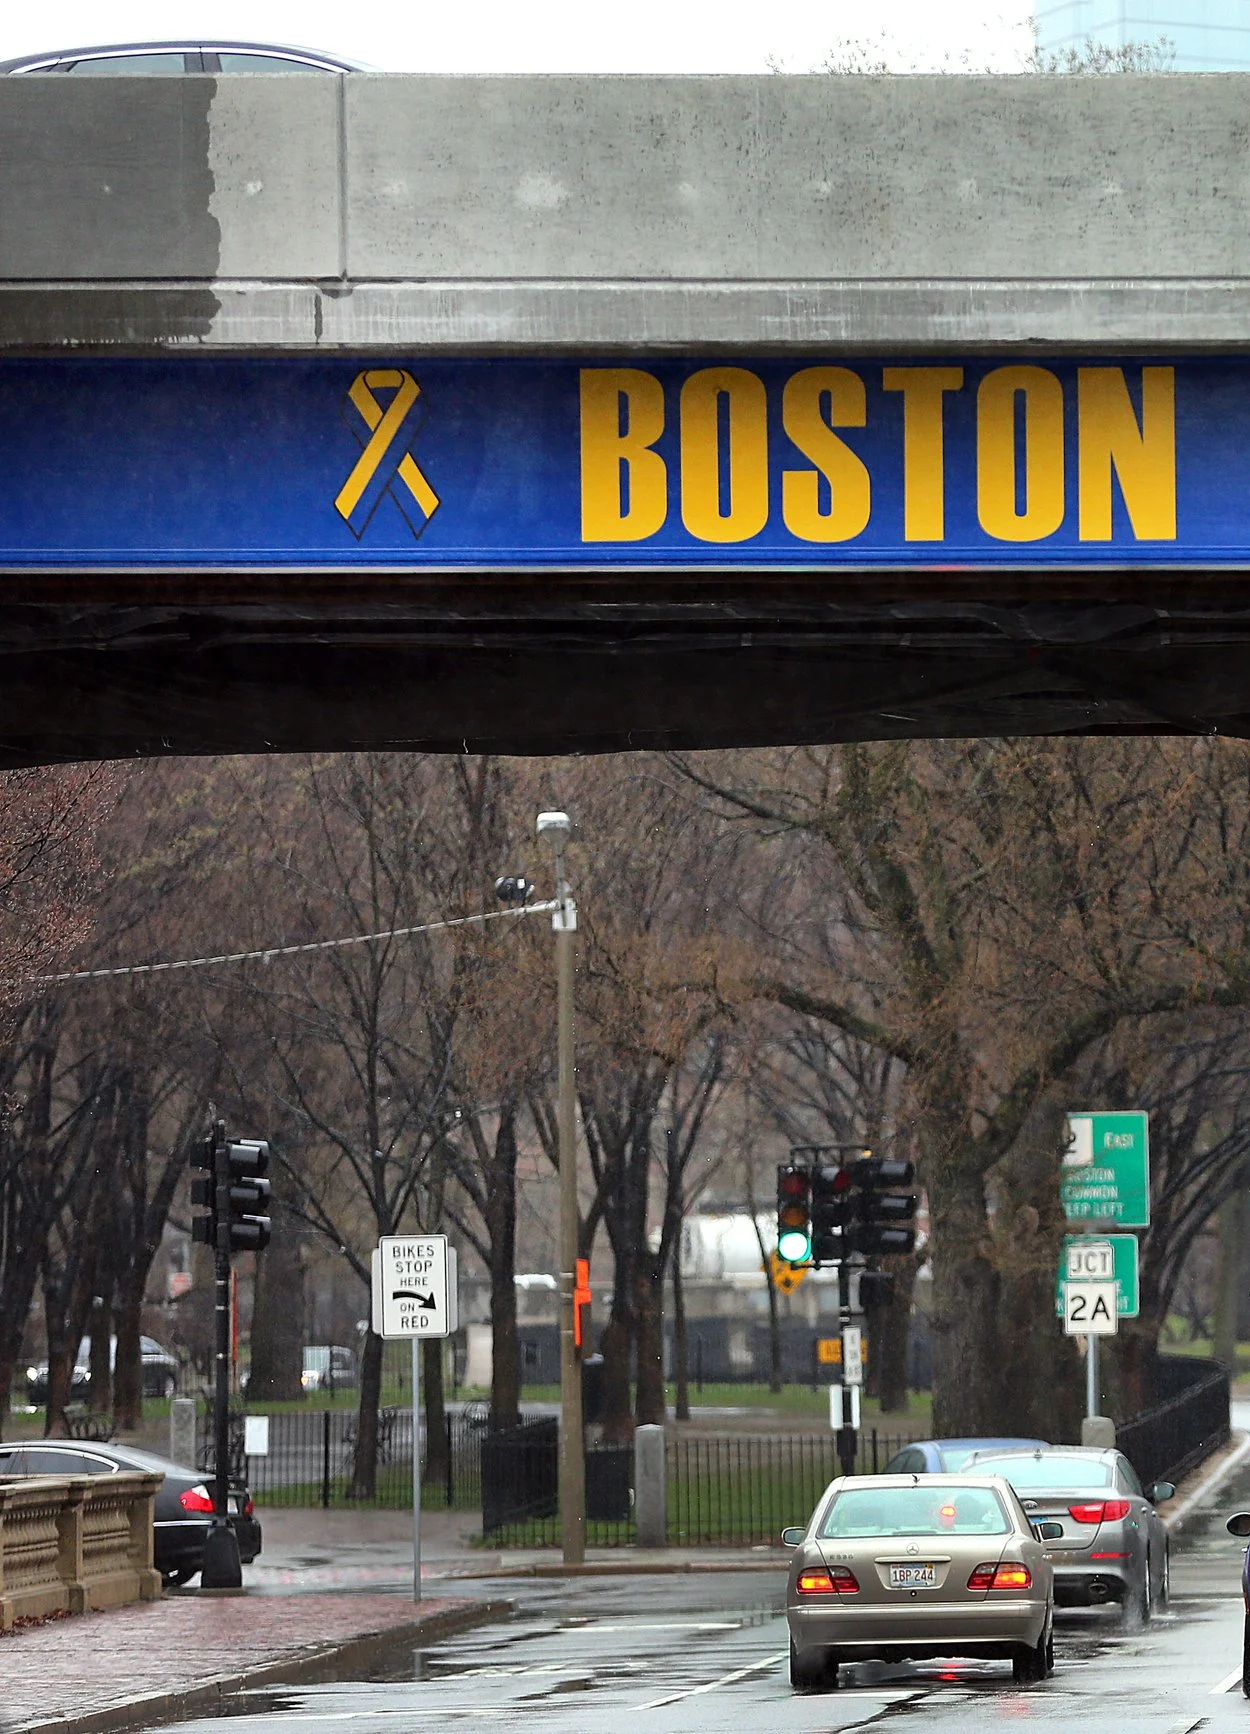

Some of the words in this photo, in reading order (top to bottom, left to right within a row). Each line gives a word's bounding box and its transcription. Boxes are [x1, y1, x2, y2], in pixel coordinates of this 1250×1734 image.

[580, 365, 1177, 542] BOSTON
[392, 1244, 435, 1258] BIKES
[395, 1260, 433, 1273] STOP
[1070, 1251, 1110, 1273] JCT
[400, 1276, 428, 1286] HERE
[400, 1302, 415, 1312] ON
[1070, 1295, 1110, 1321] 2A
[401, 1315, 429, 1329] RED
[892, 1569, 911, 1582] 1BP
[914, 1569, 933, 1582] 244
